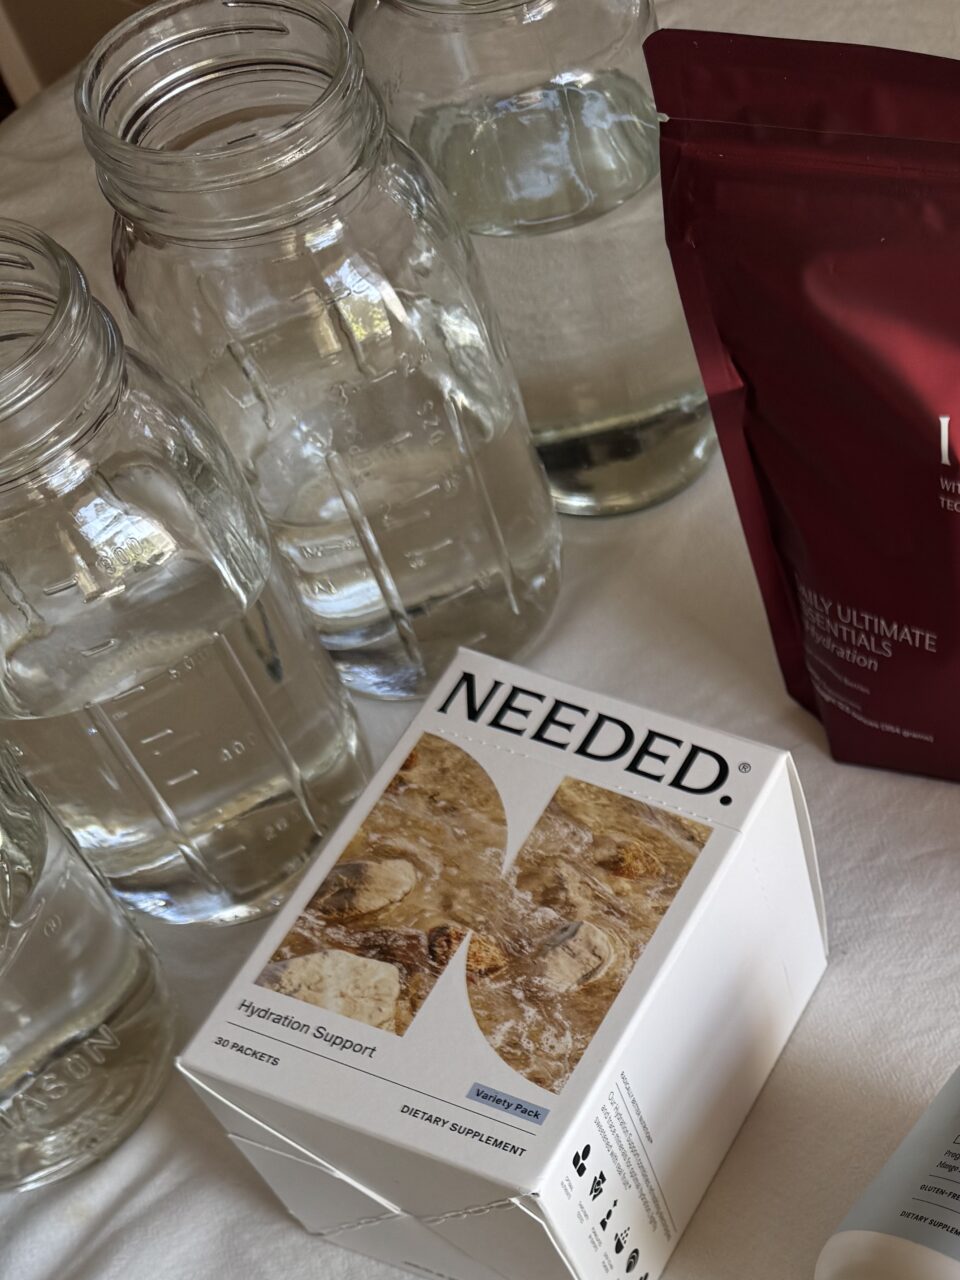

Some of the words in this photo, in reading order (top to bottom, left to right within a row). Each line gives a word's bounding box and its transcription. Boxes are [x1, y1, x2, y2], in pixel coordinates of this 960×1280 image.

[837, 604, 938, 653] ULTIMATE
[238, 999, 310, 1034] Hydration
[312, 1026, 377, 1059] Support
[214, 1036, 230, 1048] 30
[229, 1041, 281, 1067] PACKETS
[475, 1088, 513, 1110] Variety
[513, 1103, 542, 1120] Pack
[400, 1104, 449, 1128] DIETARY
[449, 1122, 527, 1158] SUPPLEMENT
[899, 1209, 930, 1224] DIETARY
